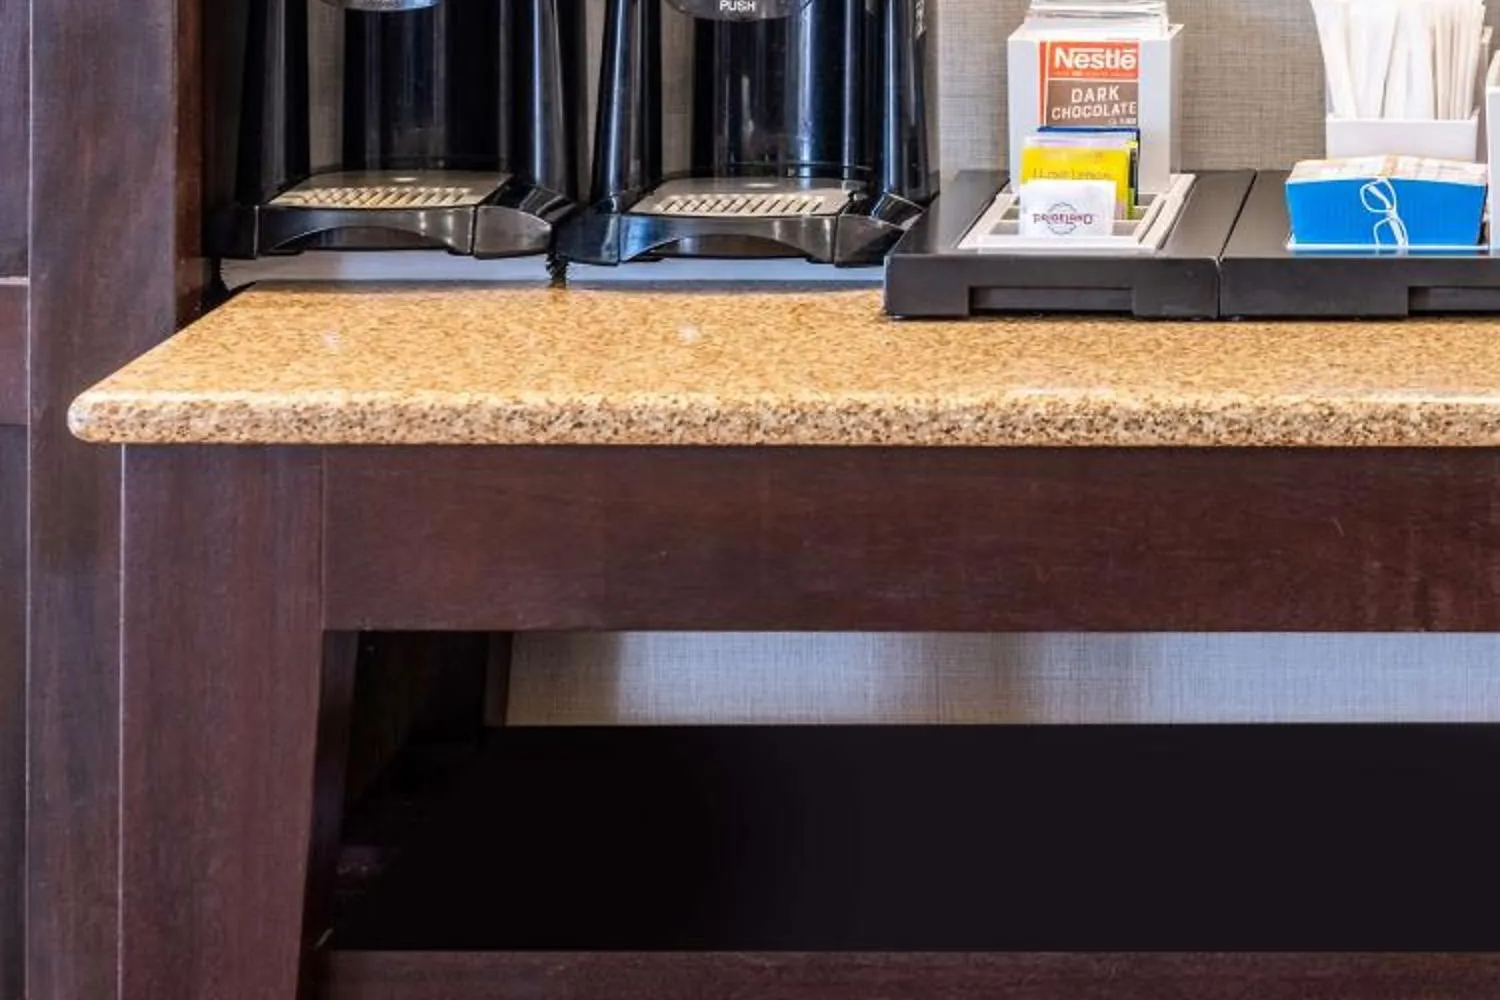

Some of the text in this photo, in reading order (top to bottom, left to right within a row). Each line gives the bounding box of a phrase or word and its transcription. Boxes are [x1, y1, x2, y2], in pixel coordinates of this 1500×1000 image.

[719, 0, 756, 13] PUSH
[1070, 84, 1120, 104] DARK
[1050, 101, 1138, 121] CHOCOLATE
